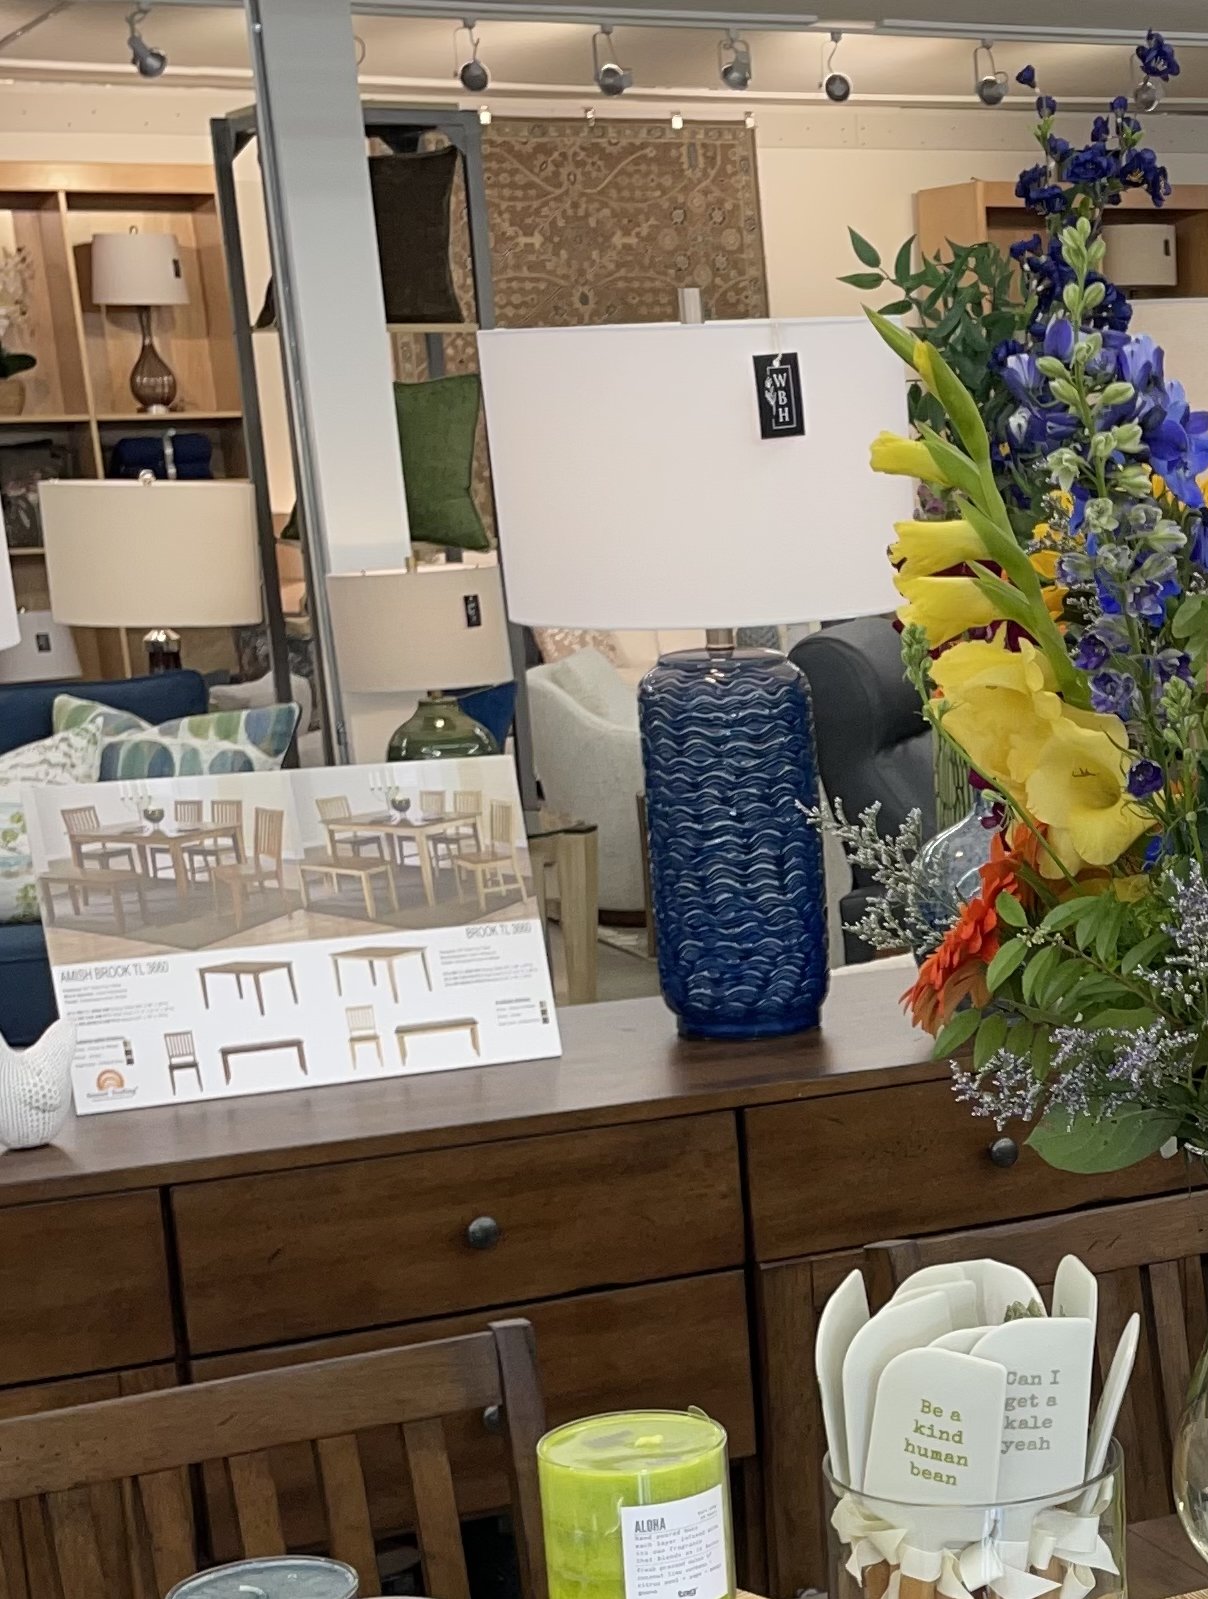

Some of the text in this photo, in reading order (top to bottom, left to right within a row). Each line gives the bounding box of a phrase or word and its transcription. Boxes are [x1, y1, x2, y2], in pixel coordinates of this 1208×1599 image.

[465, 926, 499, 939] BROOK
[61, 967, 93, 983] AMISH
[95, 963, 129, 981] BROOK
[1006, 1370, 1060, 1386] Can I
[920, 1399, 962, 1422] Be a
[1004, 1393, 1057, 1411] get a
[1004, 1416, 1053, 1430] kale
[912, 1420, 964, 1445] kind
[903, 1438, 969, 1466] human
[1001, 1438, 1051, 1455] yeah
[909, 1461, 957, 1486] bean
[635, 1518, 666, 1533] ALOHA
